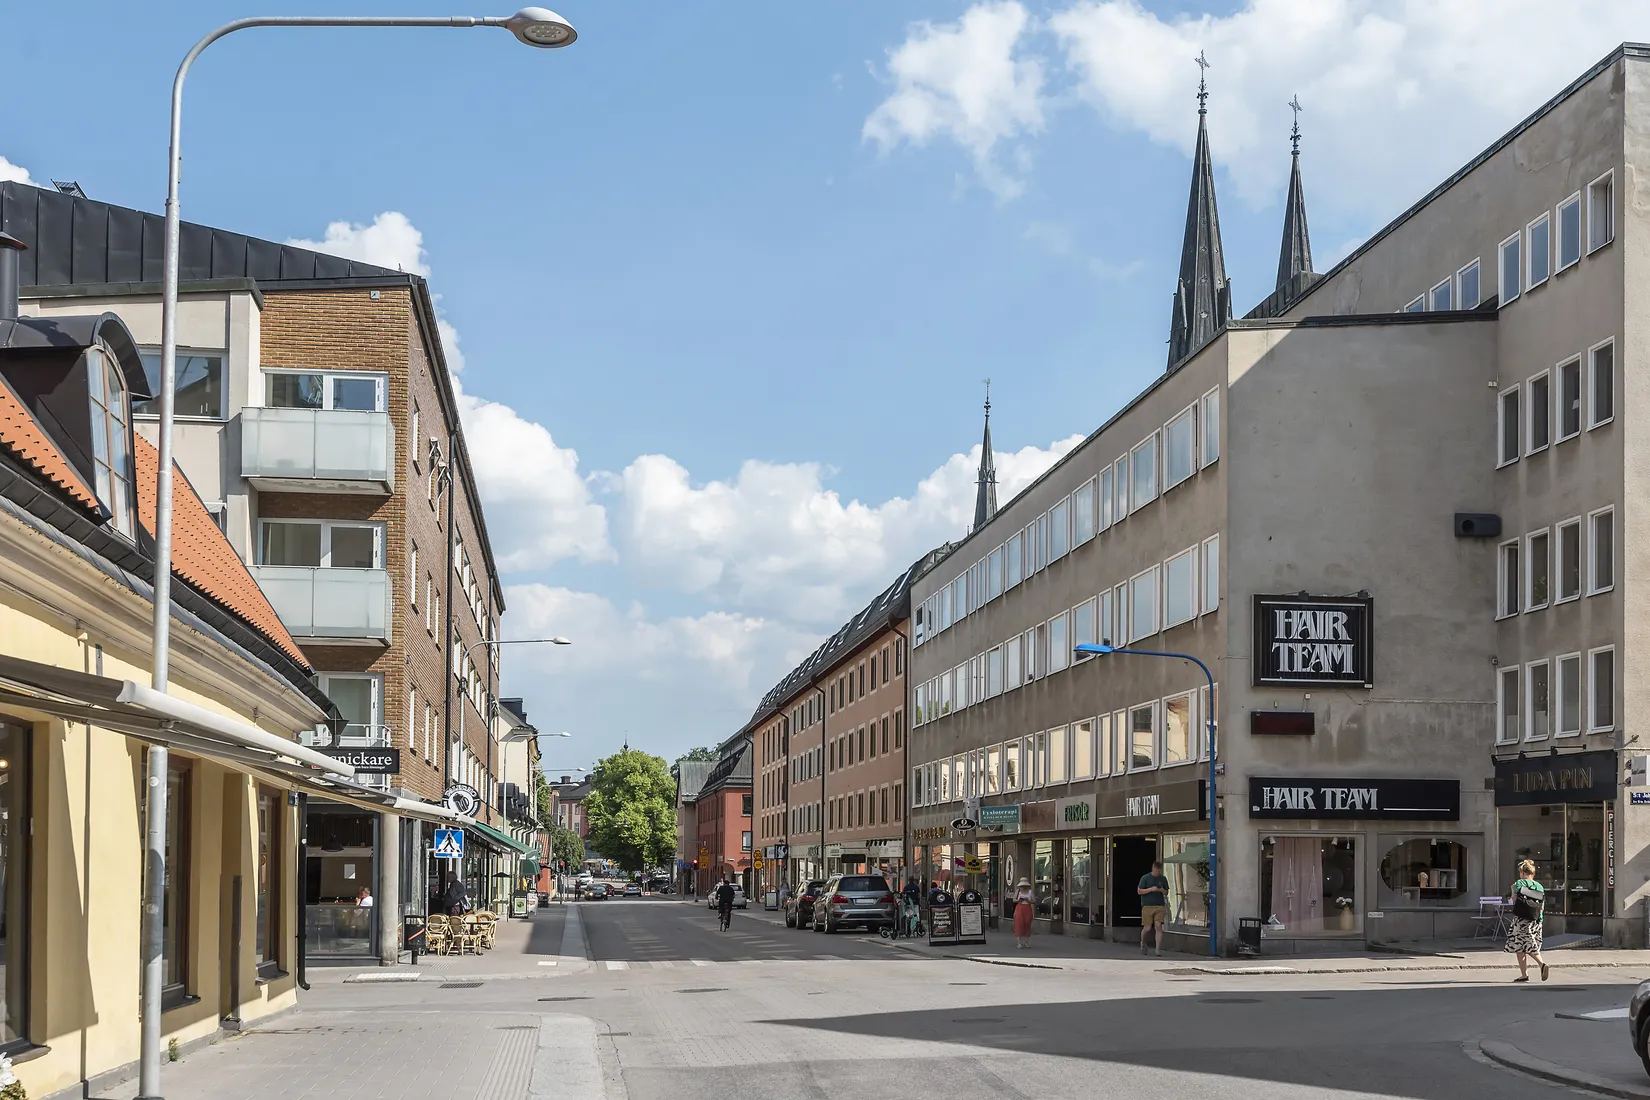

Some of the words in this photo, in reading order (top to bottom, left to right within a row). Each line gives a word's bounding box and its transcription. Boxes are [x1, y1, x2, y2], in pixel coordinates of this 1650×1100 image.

[1274, 609, 1352, 641] HAIR
[1271, 642, 1355, 674] TEAM
[1560, 766, 1594, 790] PIN
[1126, 796, 1142, 818] HAIR
[1142, 794, 1160, 816] TEAM
[1262, 787, 1316, 810] HAIR
[1320, 788, 1379, 811] TEAM
